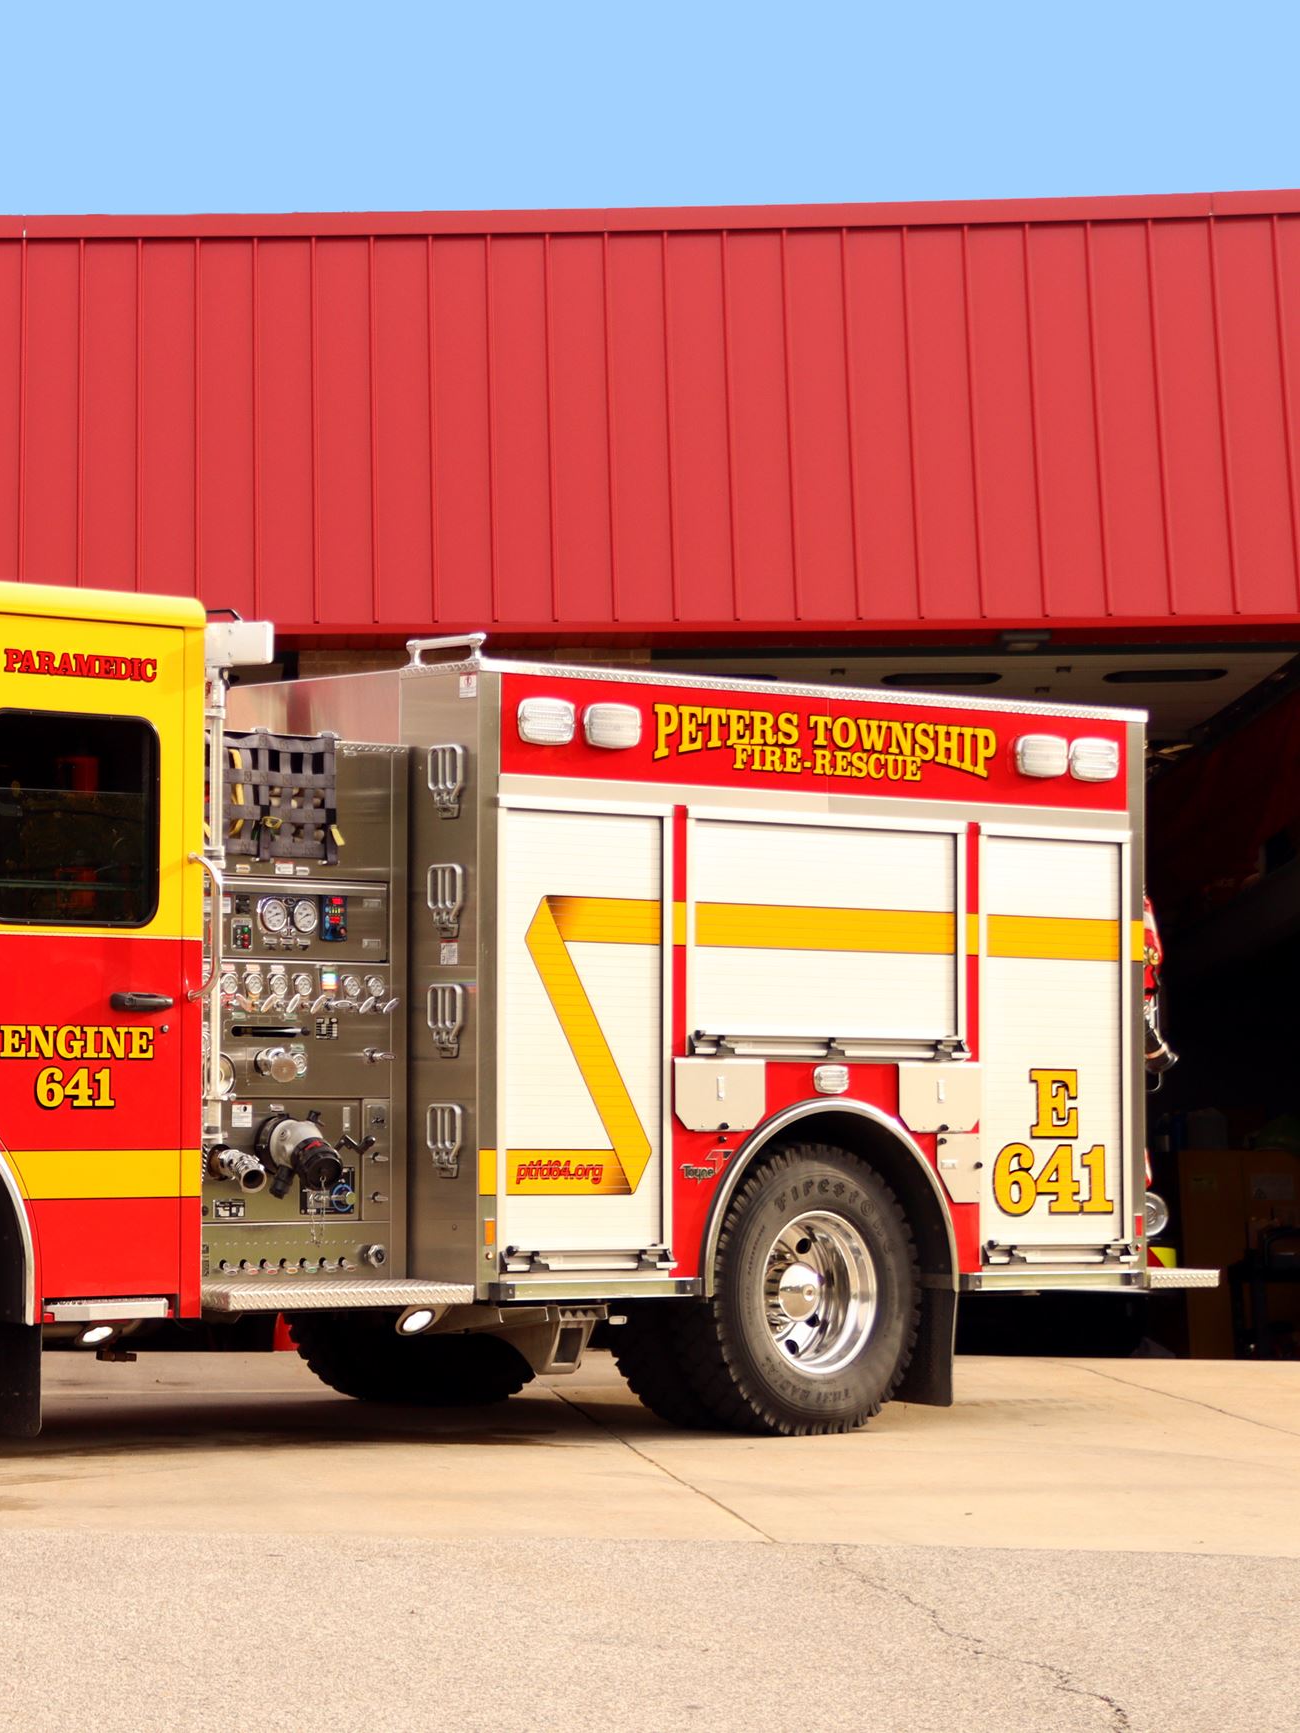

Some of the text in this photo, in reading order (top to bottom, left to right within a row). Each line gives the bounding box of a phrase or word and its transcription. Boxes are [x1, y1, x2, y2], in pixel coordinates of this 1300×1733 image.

[4, 648, 157, 683] PARAMEDIC
[653, 703, 997, 779] PETERS TOWNSHIP
[732, 744, 922, 781] FIRE-RESCUE
[35, 1066, 115, 1110] 641
[1029, 1068, 1079, 1139] E
[515, 1159, 604, 1184] ptfd64.org
[680, 1164, 715, 1184] Toyne
[992, 1142, 1114, 1217] 641
